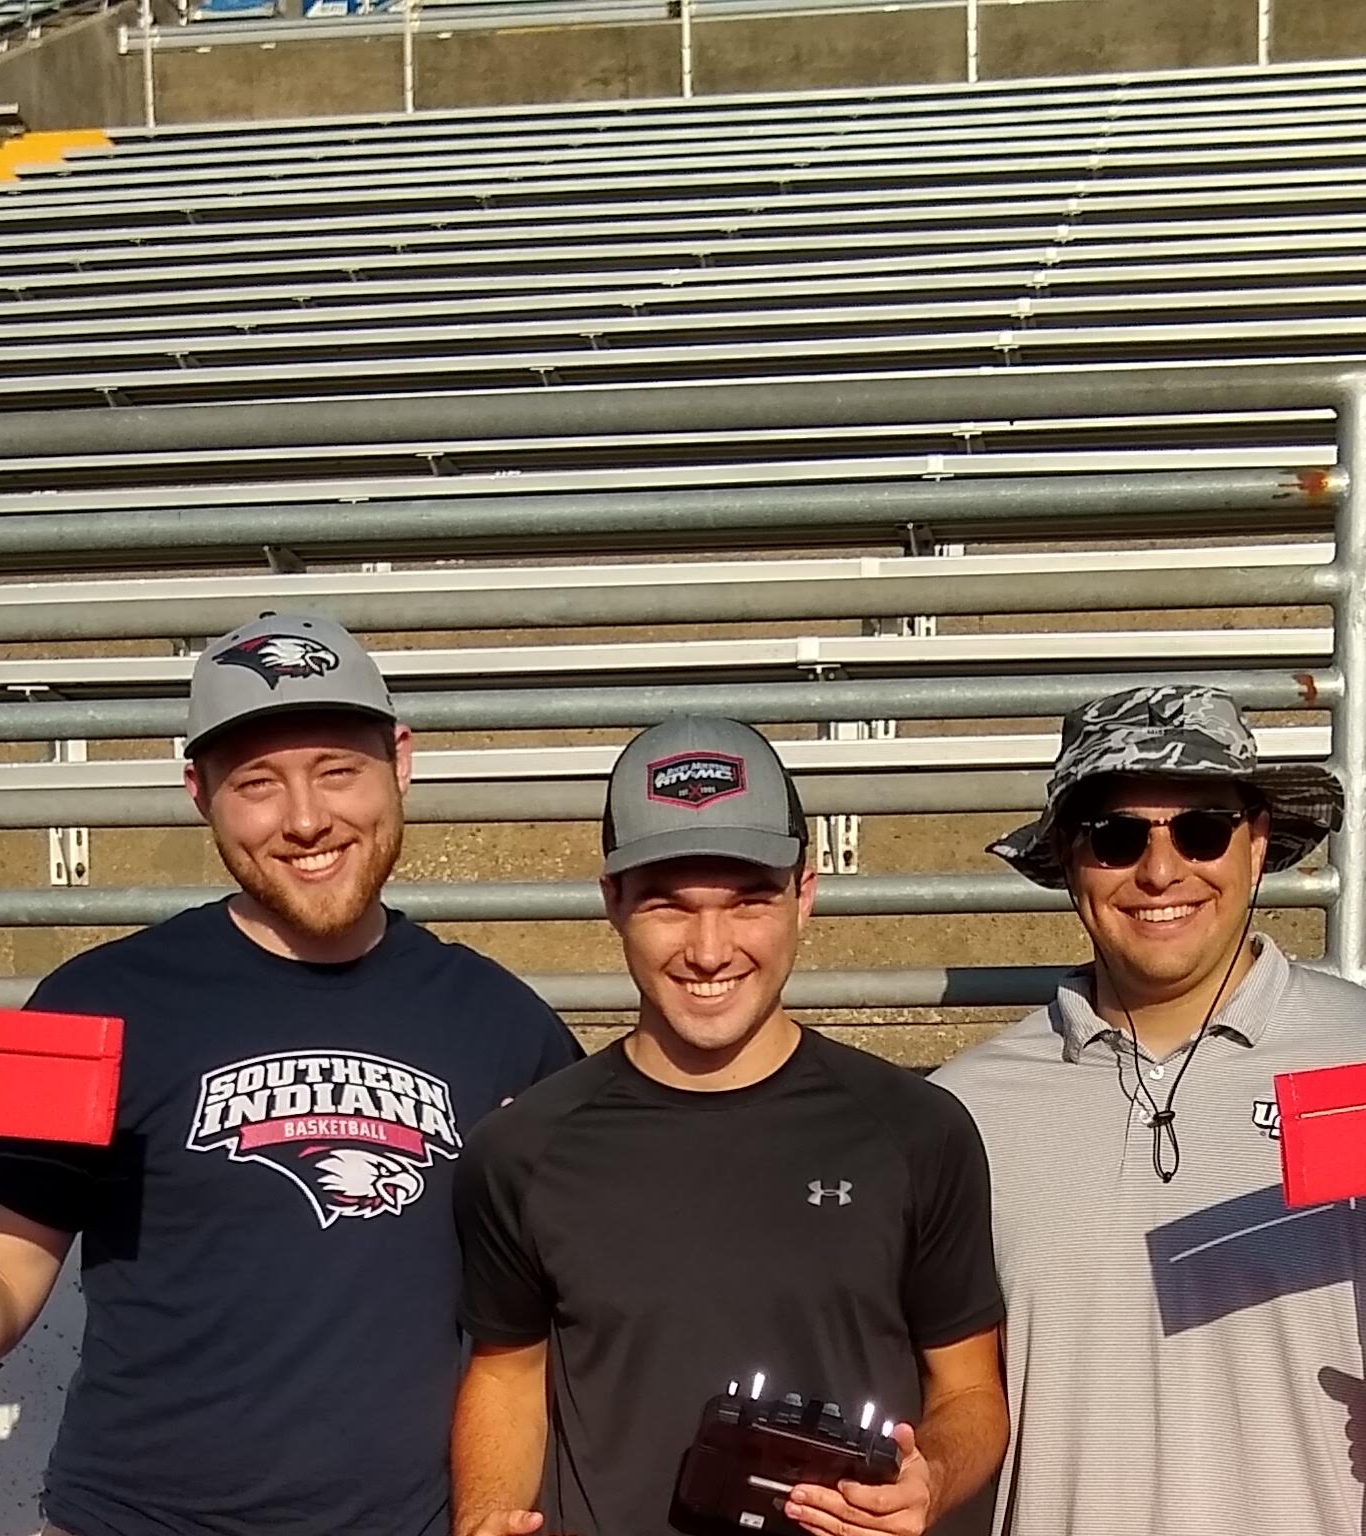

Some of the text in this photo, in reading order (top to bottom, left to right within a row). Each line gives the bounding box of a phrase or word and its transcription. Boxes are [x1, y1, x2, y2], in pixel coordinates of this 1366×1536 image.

[208, 1058, 446, 1112] SOUTHERN
[198, 1083, 456, 1147] INDIANA
[284, 1117, 387, 1141] BASKETBALL
